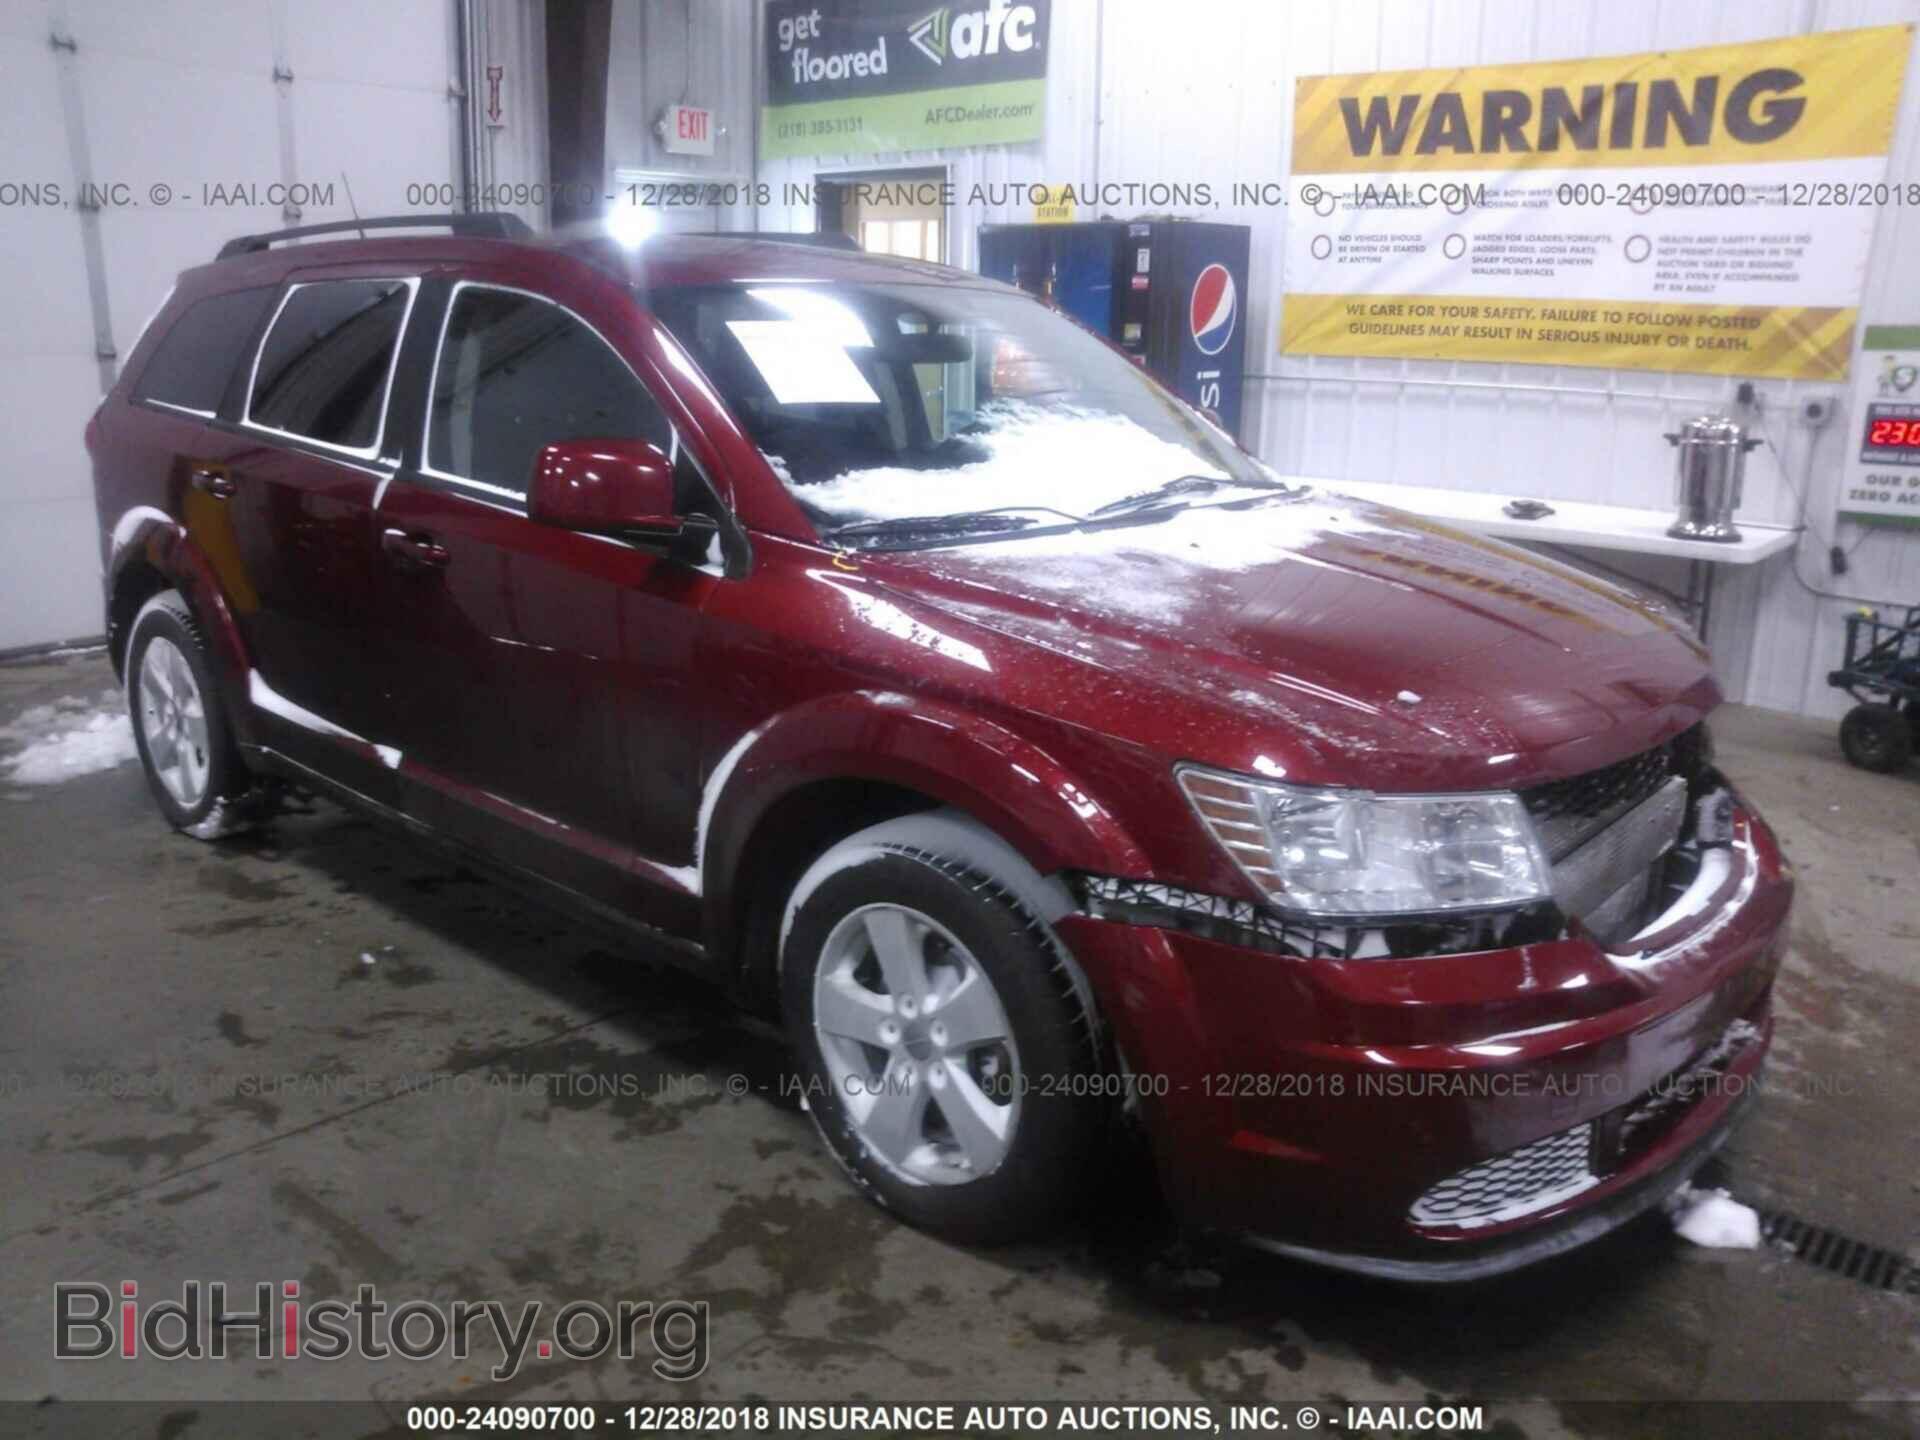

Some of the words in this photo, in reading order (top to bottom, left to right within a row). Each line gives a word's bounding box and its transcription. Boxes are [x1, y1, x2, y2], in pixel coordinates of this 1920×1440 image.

[778, 8, 821, 52] get
[950, 0, 1036, 60] afc
[791, 37, 888, 83] floored
[678, 109, 709, 141] EXIT
[925, 104, 1033, 126] AFCDealer.com
[1339, 68, 1808, 157] WARNING
[1346, 304, 1366, 316] WE
[1370, 304, 1404, 317] CARE
[1408, 305, 1435, 317] FOR
[1440, 305, 1480, 318] YOUR
[1484, 306, 1536, 320] SAFETY.
[1540, 308, 1598, 322] FAILURE
[1602, 310, 1623, 324] TO
[1627, 311, 1692, 327] FOLLOW
[1697, 314, 1761, 330] POSTED
[1350, 322, 1425, 336] GUIDELINES
[1429, 324, 1460, 337] MAY
[1464, 325, 1512, 340] RESULT
[1516, 327, 1532, 340] IN
[1537, 328, 1600, 344] SERIOUS
[1605, 332, 1661, 346] INJURY
[1667, 335, 1689, 348] OR
[1696, 336, 1753, 351] DEATH.
